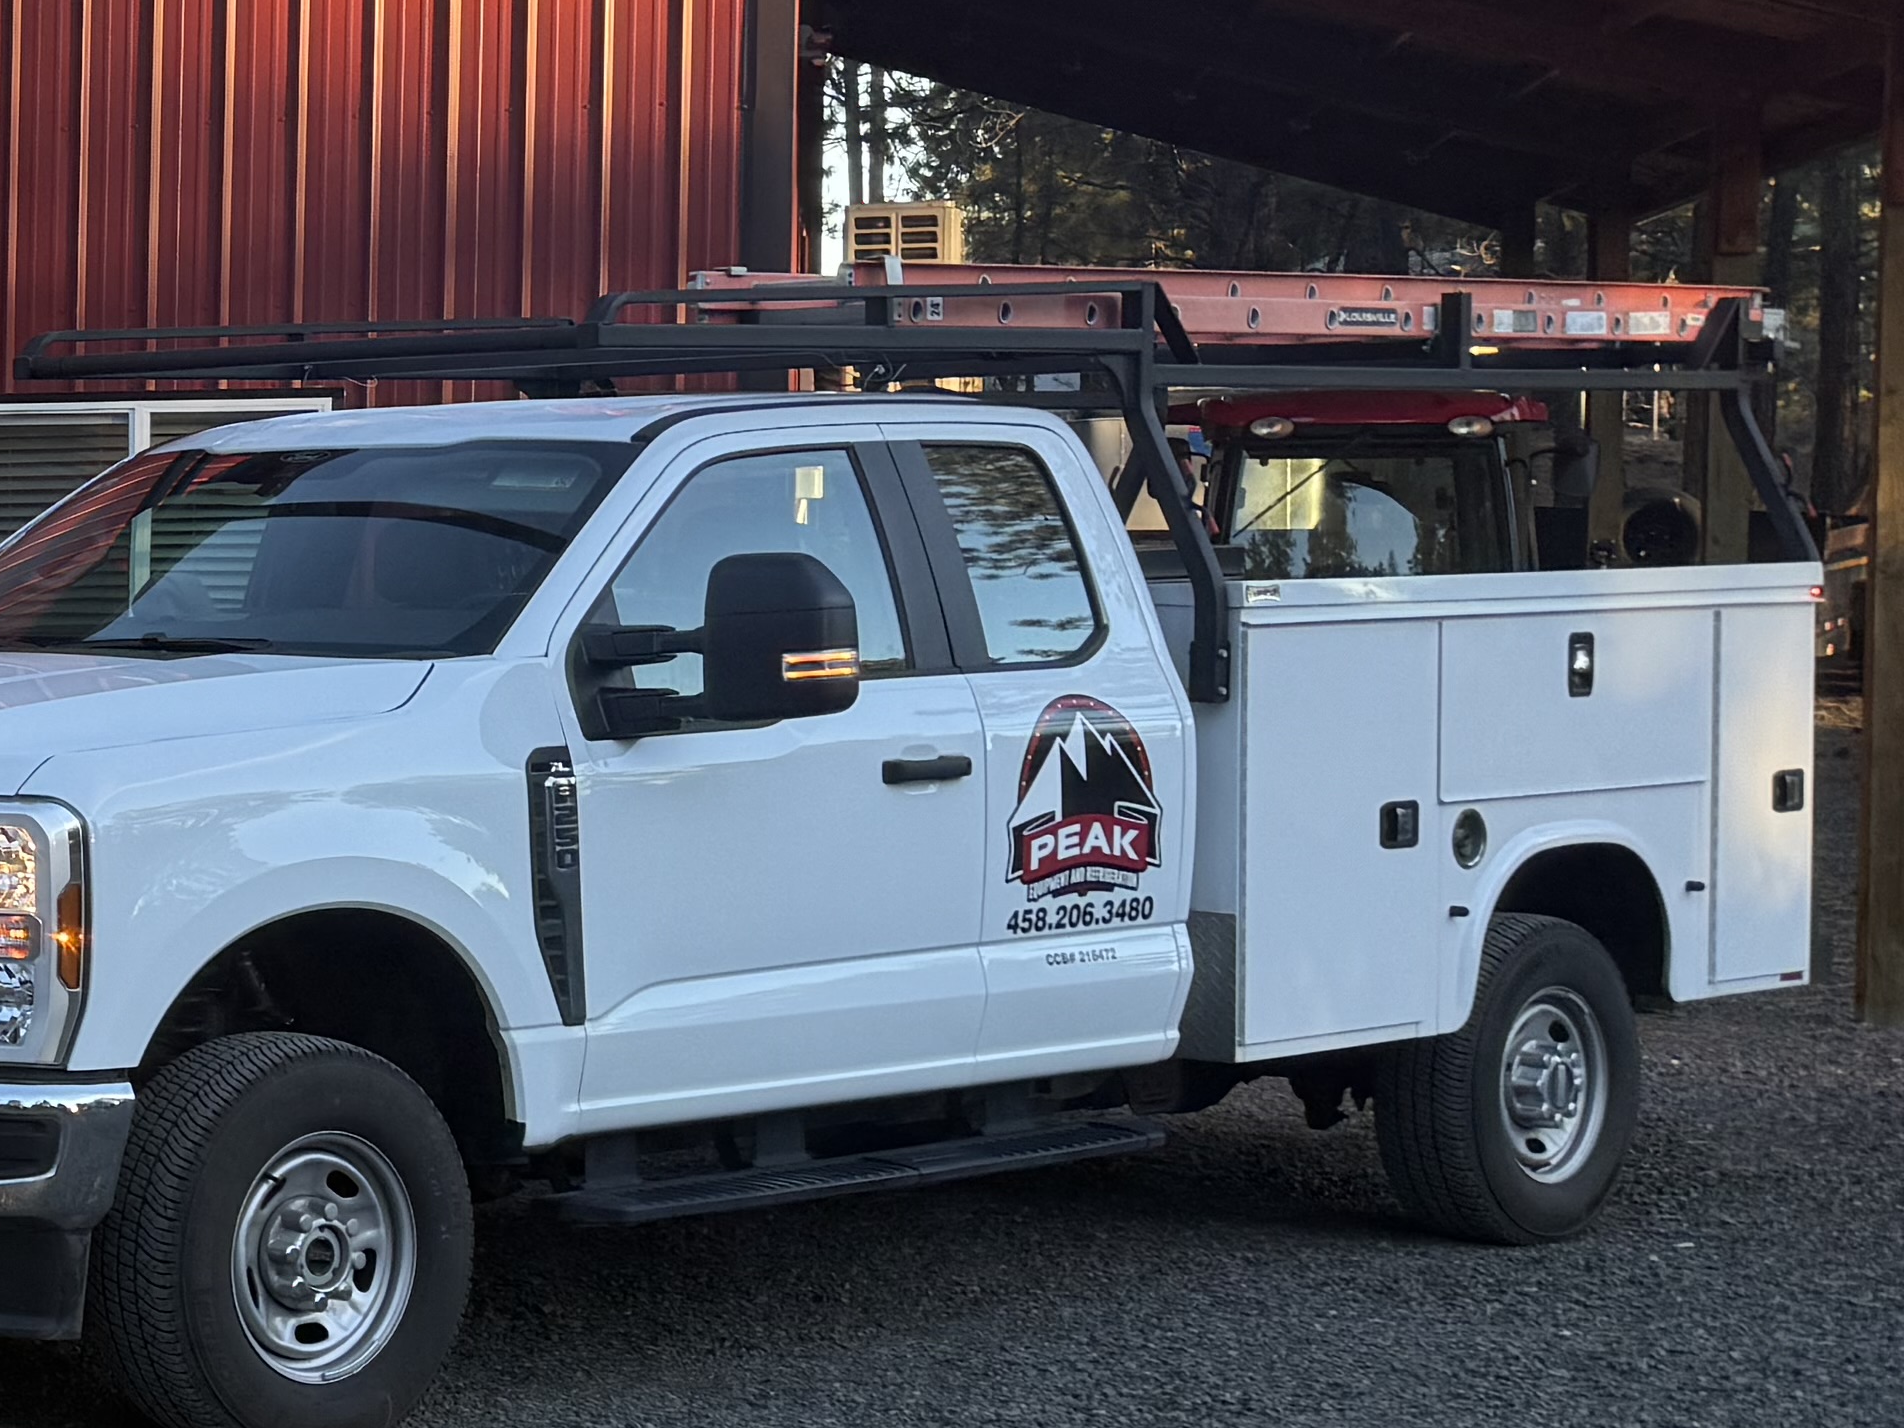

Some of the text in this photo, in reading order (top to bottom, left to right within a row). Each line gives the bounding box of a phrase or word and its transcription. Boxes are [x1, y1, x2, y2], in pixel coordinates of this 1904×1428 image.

[930, 299, 940, 316] 24
[1345, 312, 1396, 322] LOUISVILLE
[1030, 821, 1140, 871] PEAK
[1006, 896, 1154, 934] 458.206.3480
[1046, 953, 1075, 966] CCB#
